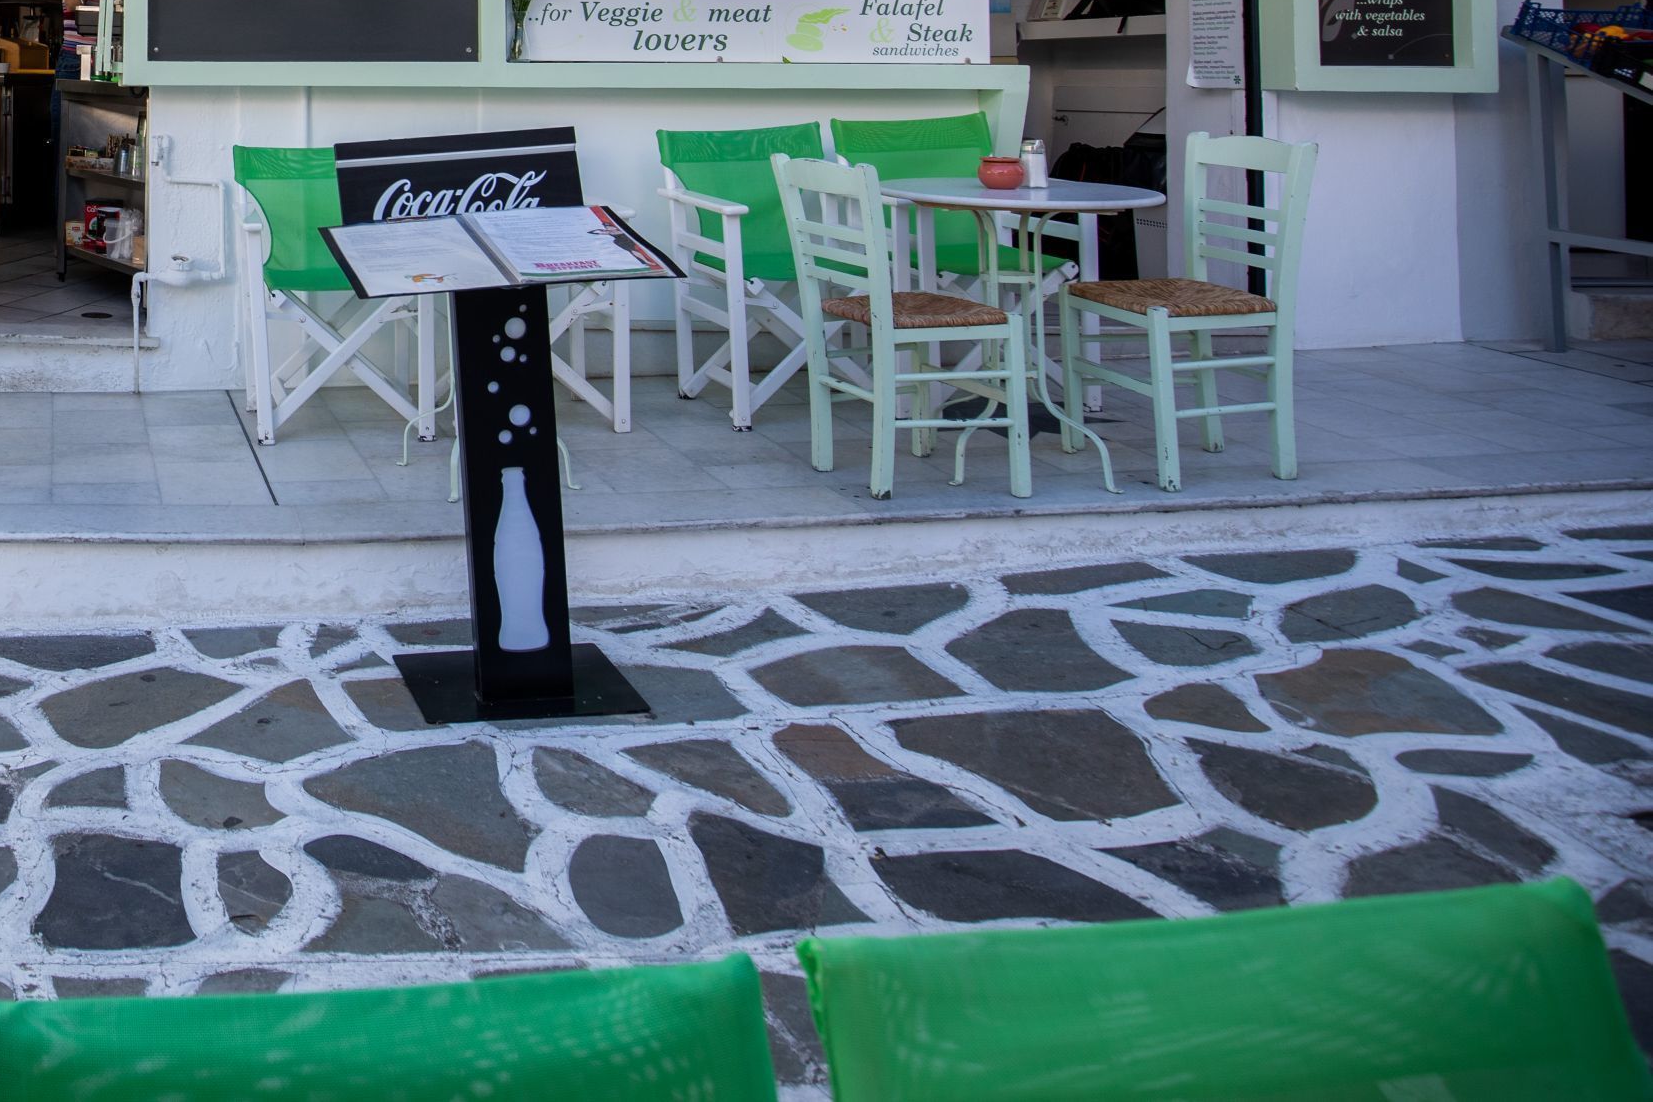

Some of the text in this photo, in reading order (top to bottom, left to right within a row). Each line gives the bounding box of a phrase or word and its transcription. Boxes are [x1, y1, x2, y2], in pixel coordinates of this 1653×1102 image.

[580, 1, 663, 27] Veggie
[708, 5, 772, 23] meat
[1335, 8, 1425, 24] with vegetables
[869, 18, 973, 43] & Steak
[1356, 24, 1403, 36] & salsa
[633, 30, 728, 51] lovers
[872, 43, 959, 57] sandwiches
